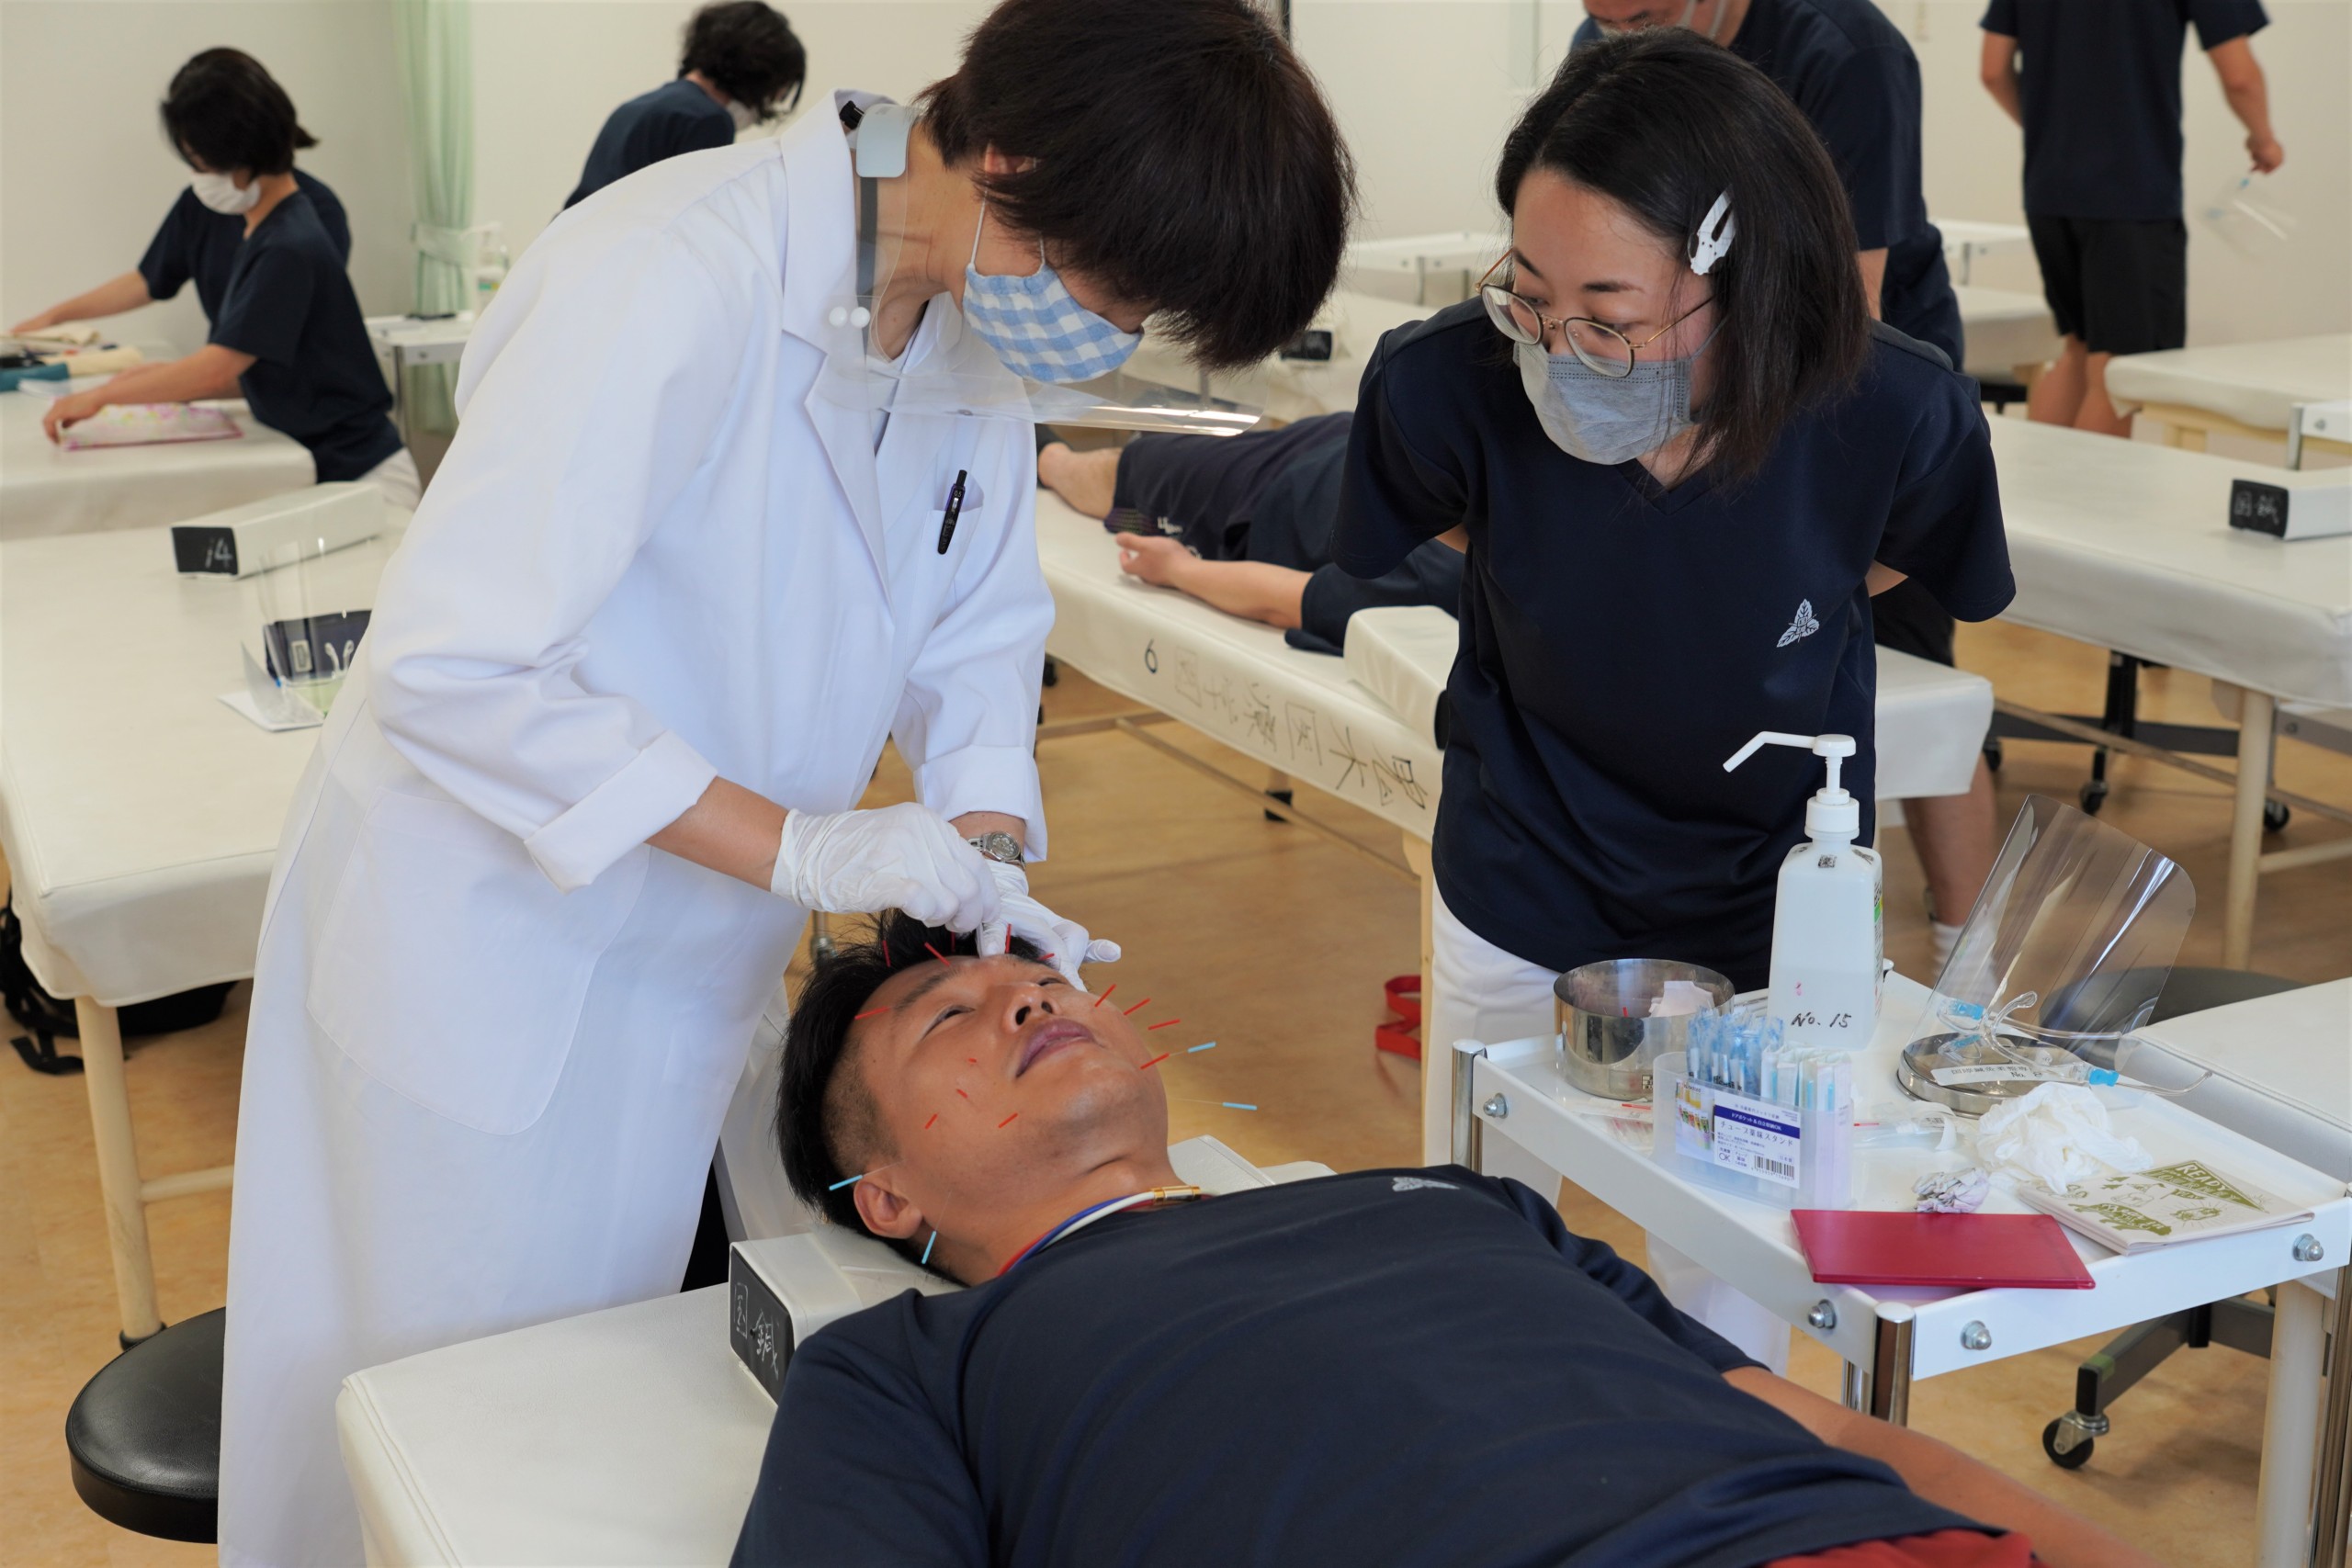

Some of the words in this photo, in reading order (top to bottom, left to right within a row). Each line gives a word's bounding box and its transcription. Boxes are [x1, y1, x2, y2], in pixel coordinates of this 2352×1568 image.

[1145, 638, 1158, 673] 6
[1791, 1011, 1821, 1027] No.
[1829, 1013, 1852, 1028] 15
[2175, 1164, 2226, 1191] READY
